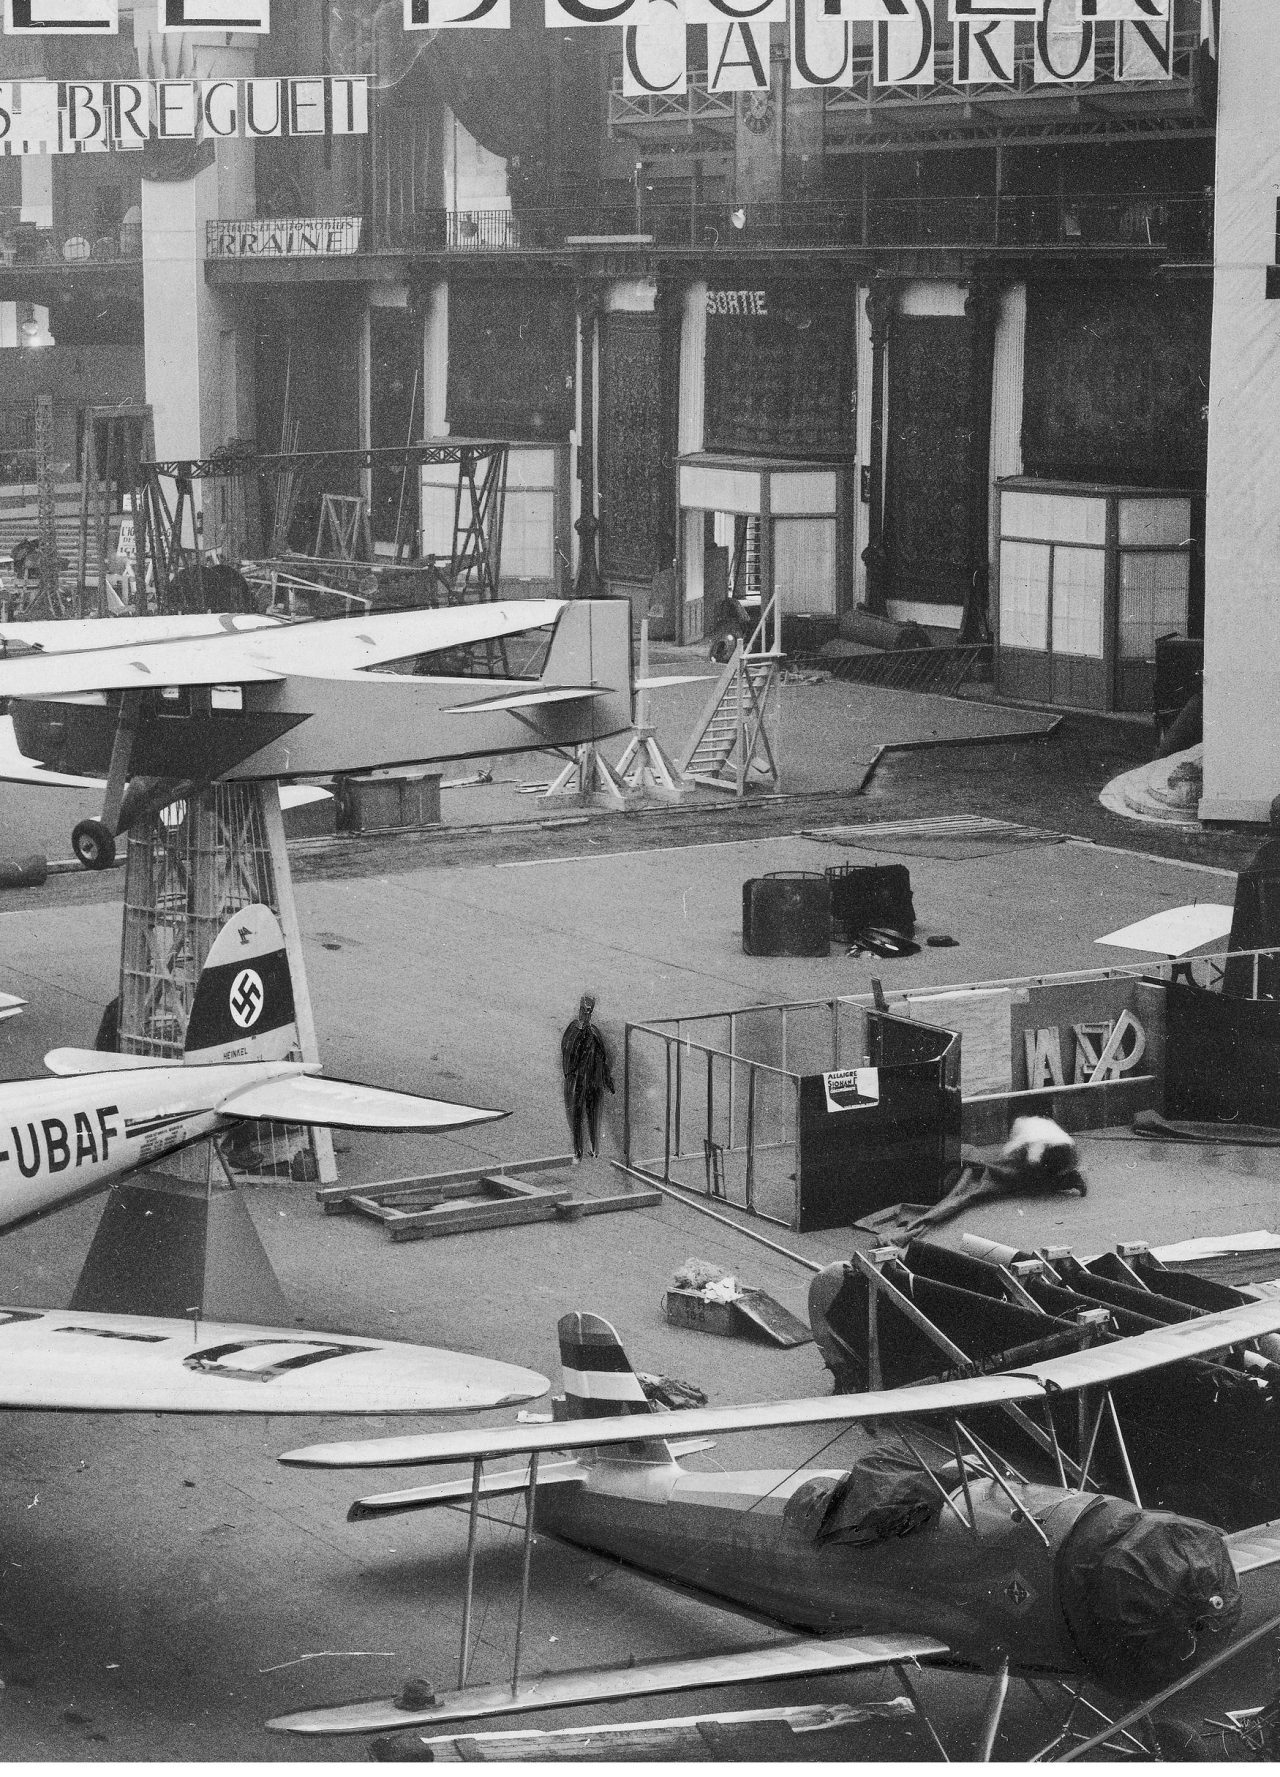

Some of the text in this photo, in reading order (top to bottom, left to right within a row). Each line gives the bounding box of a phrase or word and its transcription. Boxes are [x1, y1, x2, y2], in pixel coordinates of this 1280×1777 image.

[625, 0, 1173, 91] CAUDRON
[70, 79, 366, 140] BREGUET
[705, 290, 769, 315] SORTIE
[223, 1047, 249, 1061] HEINKEL
